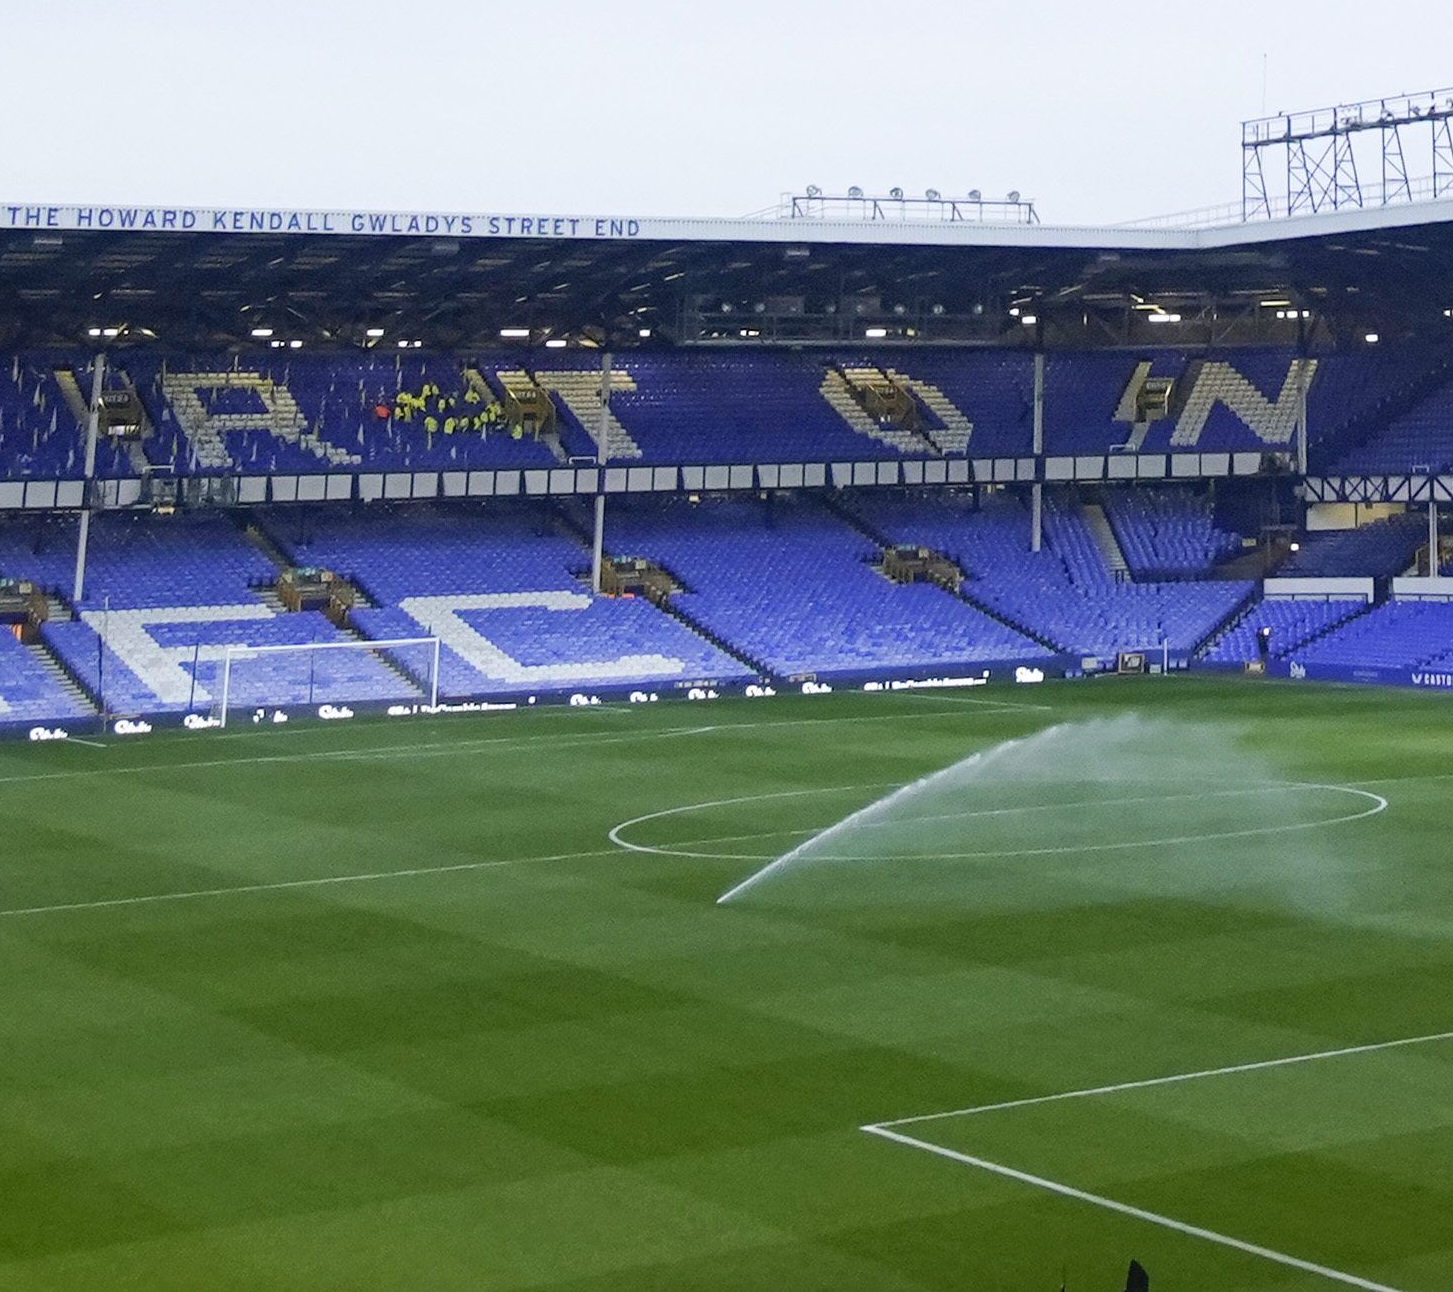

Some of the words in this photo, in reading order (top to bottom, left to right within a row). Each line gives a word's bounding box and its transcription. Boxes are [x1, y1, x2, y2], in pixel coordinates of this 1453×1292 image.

[7, 206, 60, 227] THE
[77, 208, 197, 229] HOWARD
[212, 210, 335, 231] KENDALL
[351, 214, 473, 234] GWLADYS
[488, 217, 580, 235] STREET
[595, 219, 640, 236] END
